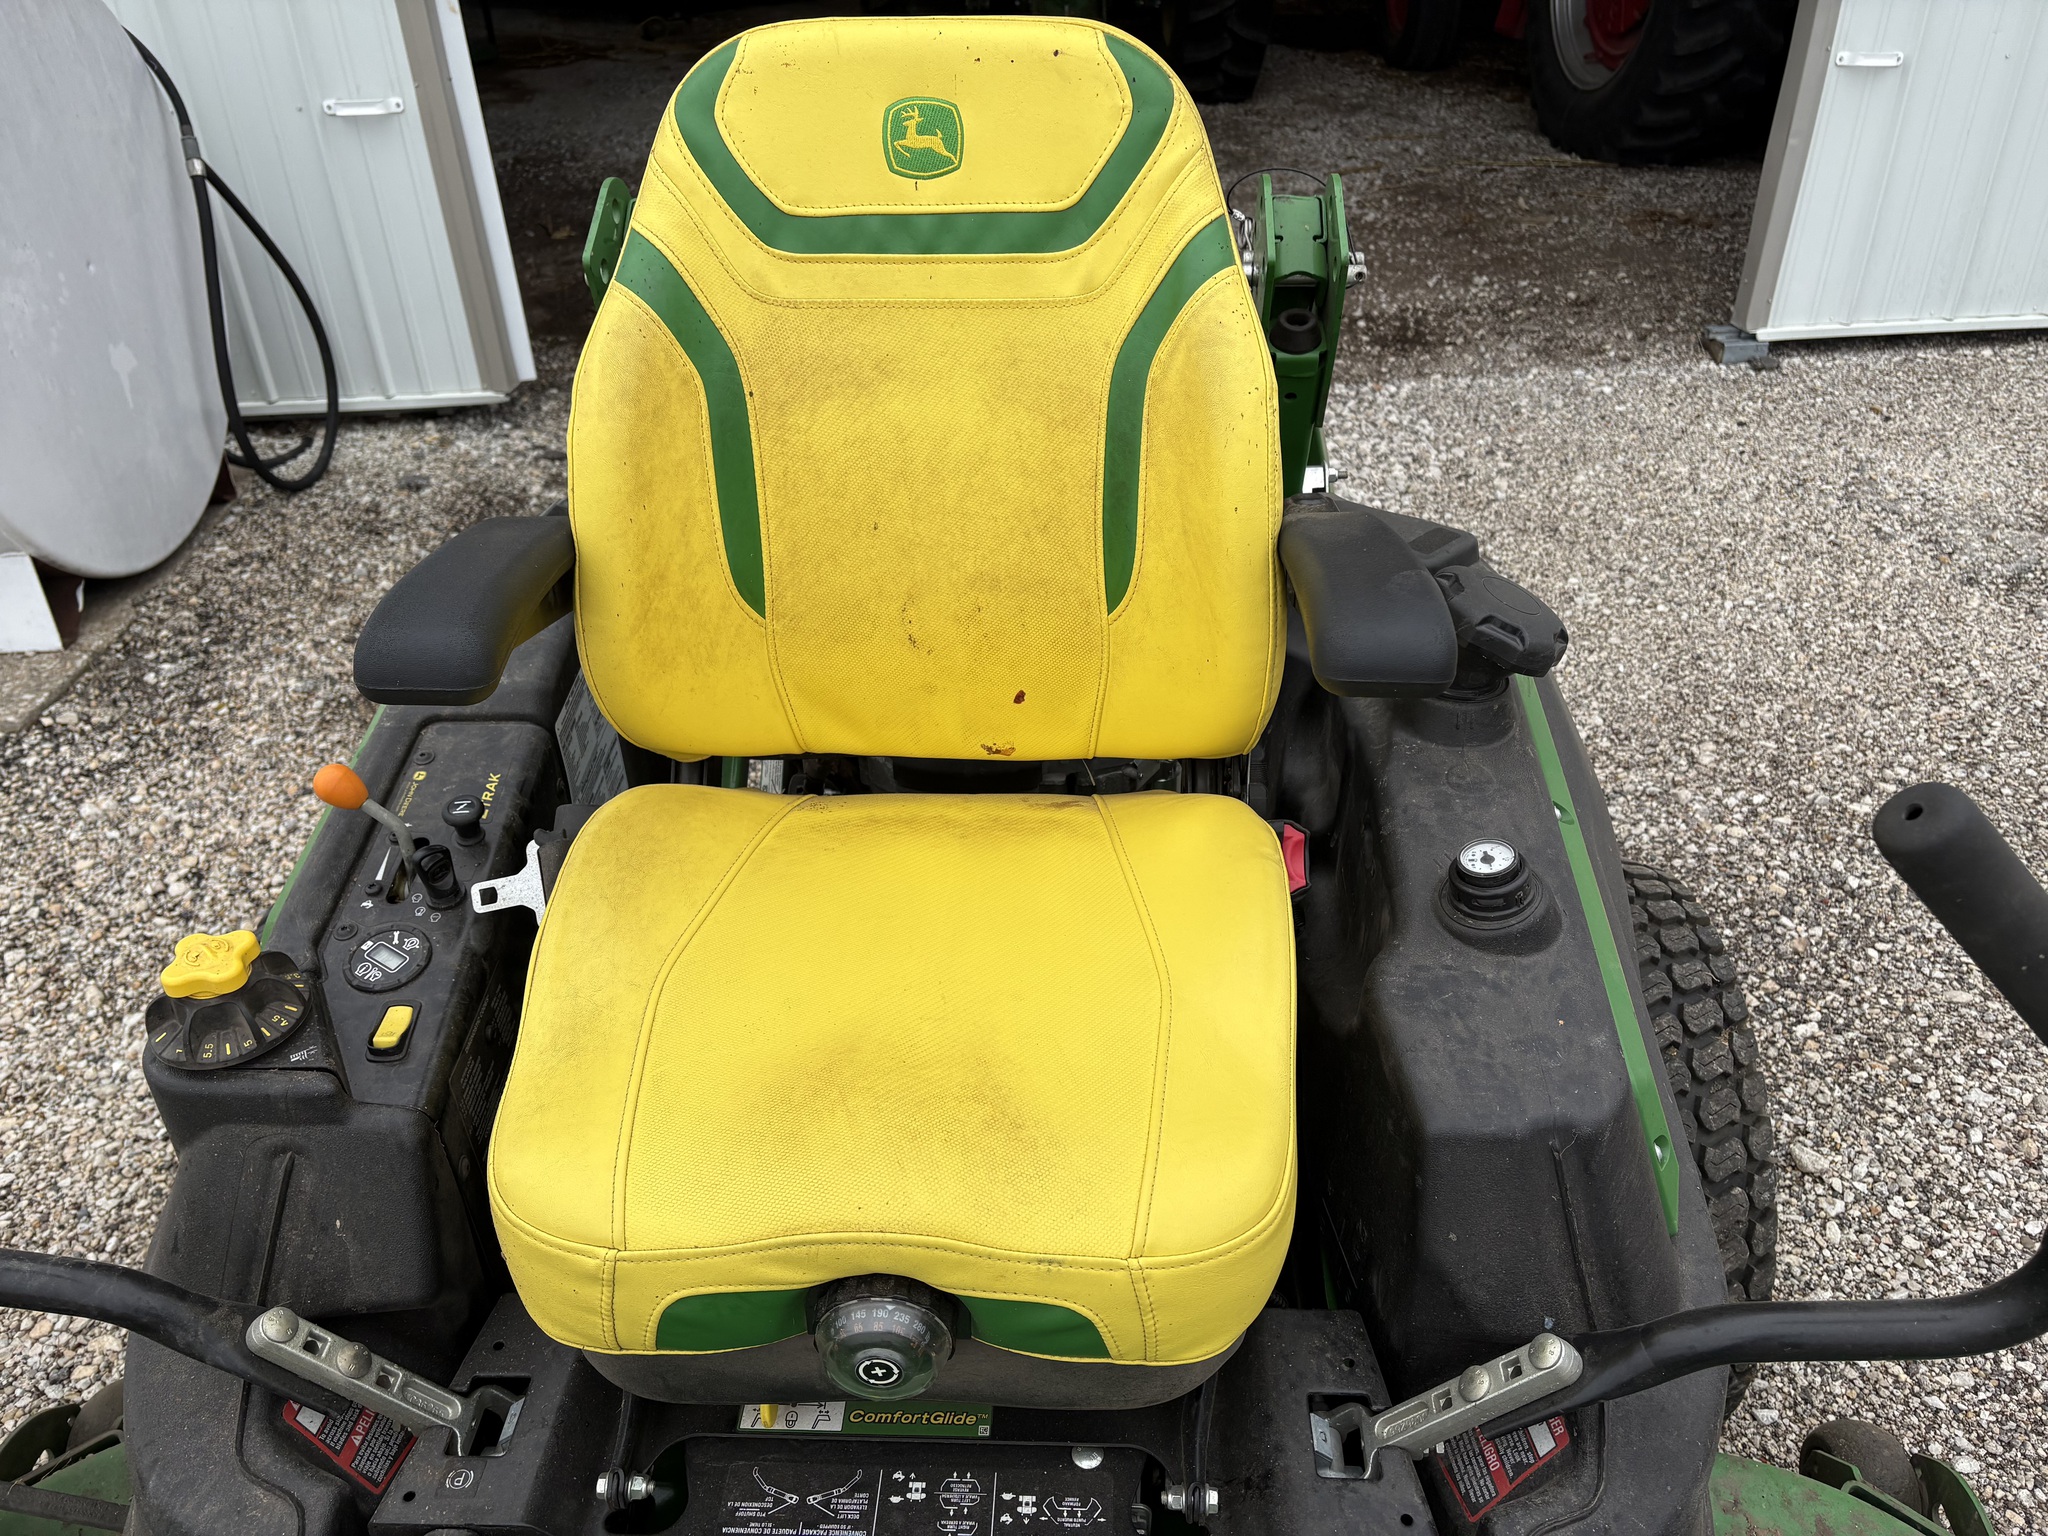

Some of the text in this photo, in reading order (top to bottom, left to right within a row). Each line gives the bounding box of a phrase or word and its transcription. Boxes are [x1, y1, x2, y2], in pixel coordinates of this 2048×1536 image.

[406, 780, 419, 798] JOHN
[397, 796, 412, 818] DEERE
[271, 1014, 289, 1027] 4.5
[203, 1043, 214, 1059] 5.5
[243, 1039, 253, 1048] 5
[835, 1316, 847, 1329] 100
[851, 1309, 866, 1320] 145
[872, 1308, 889, 1318] 190
[893, 1311, 910, 1324] 235
[912, 1320, 926, 1334] 280
[322, 1418, 334, 1434] avoid
[334, 1431, 347, 1450] blades
[344, 1420, 353, 1431] and
[349, 1408, 360, 1421] back
[355, 1408, 375, 1434] PELI
[324, 1425, 337, 1443] across
[332, 1419, 347, 1442] machine
[350, 1454, 361, 1468] Para
